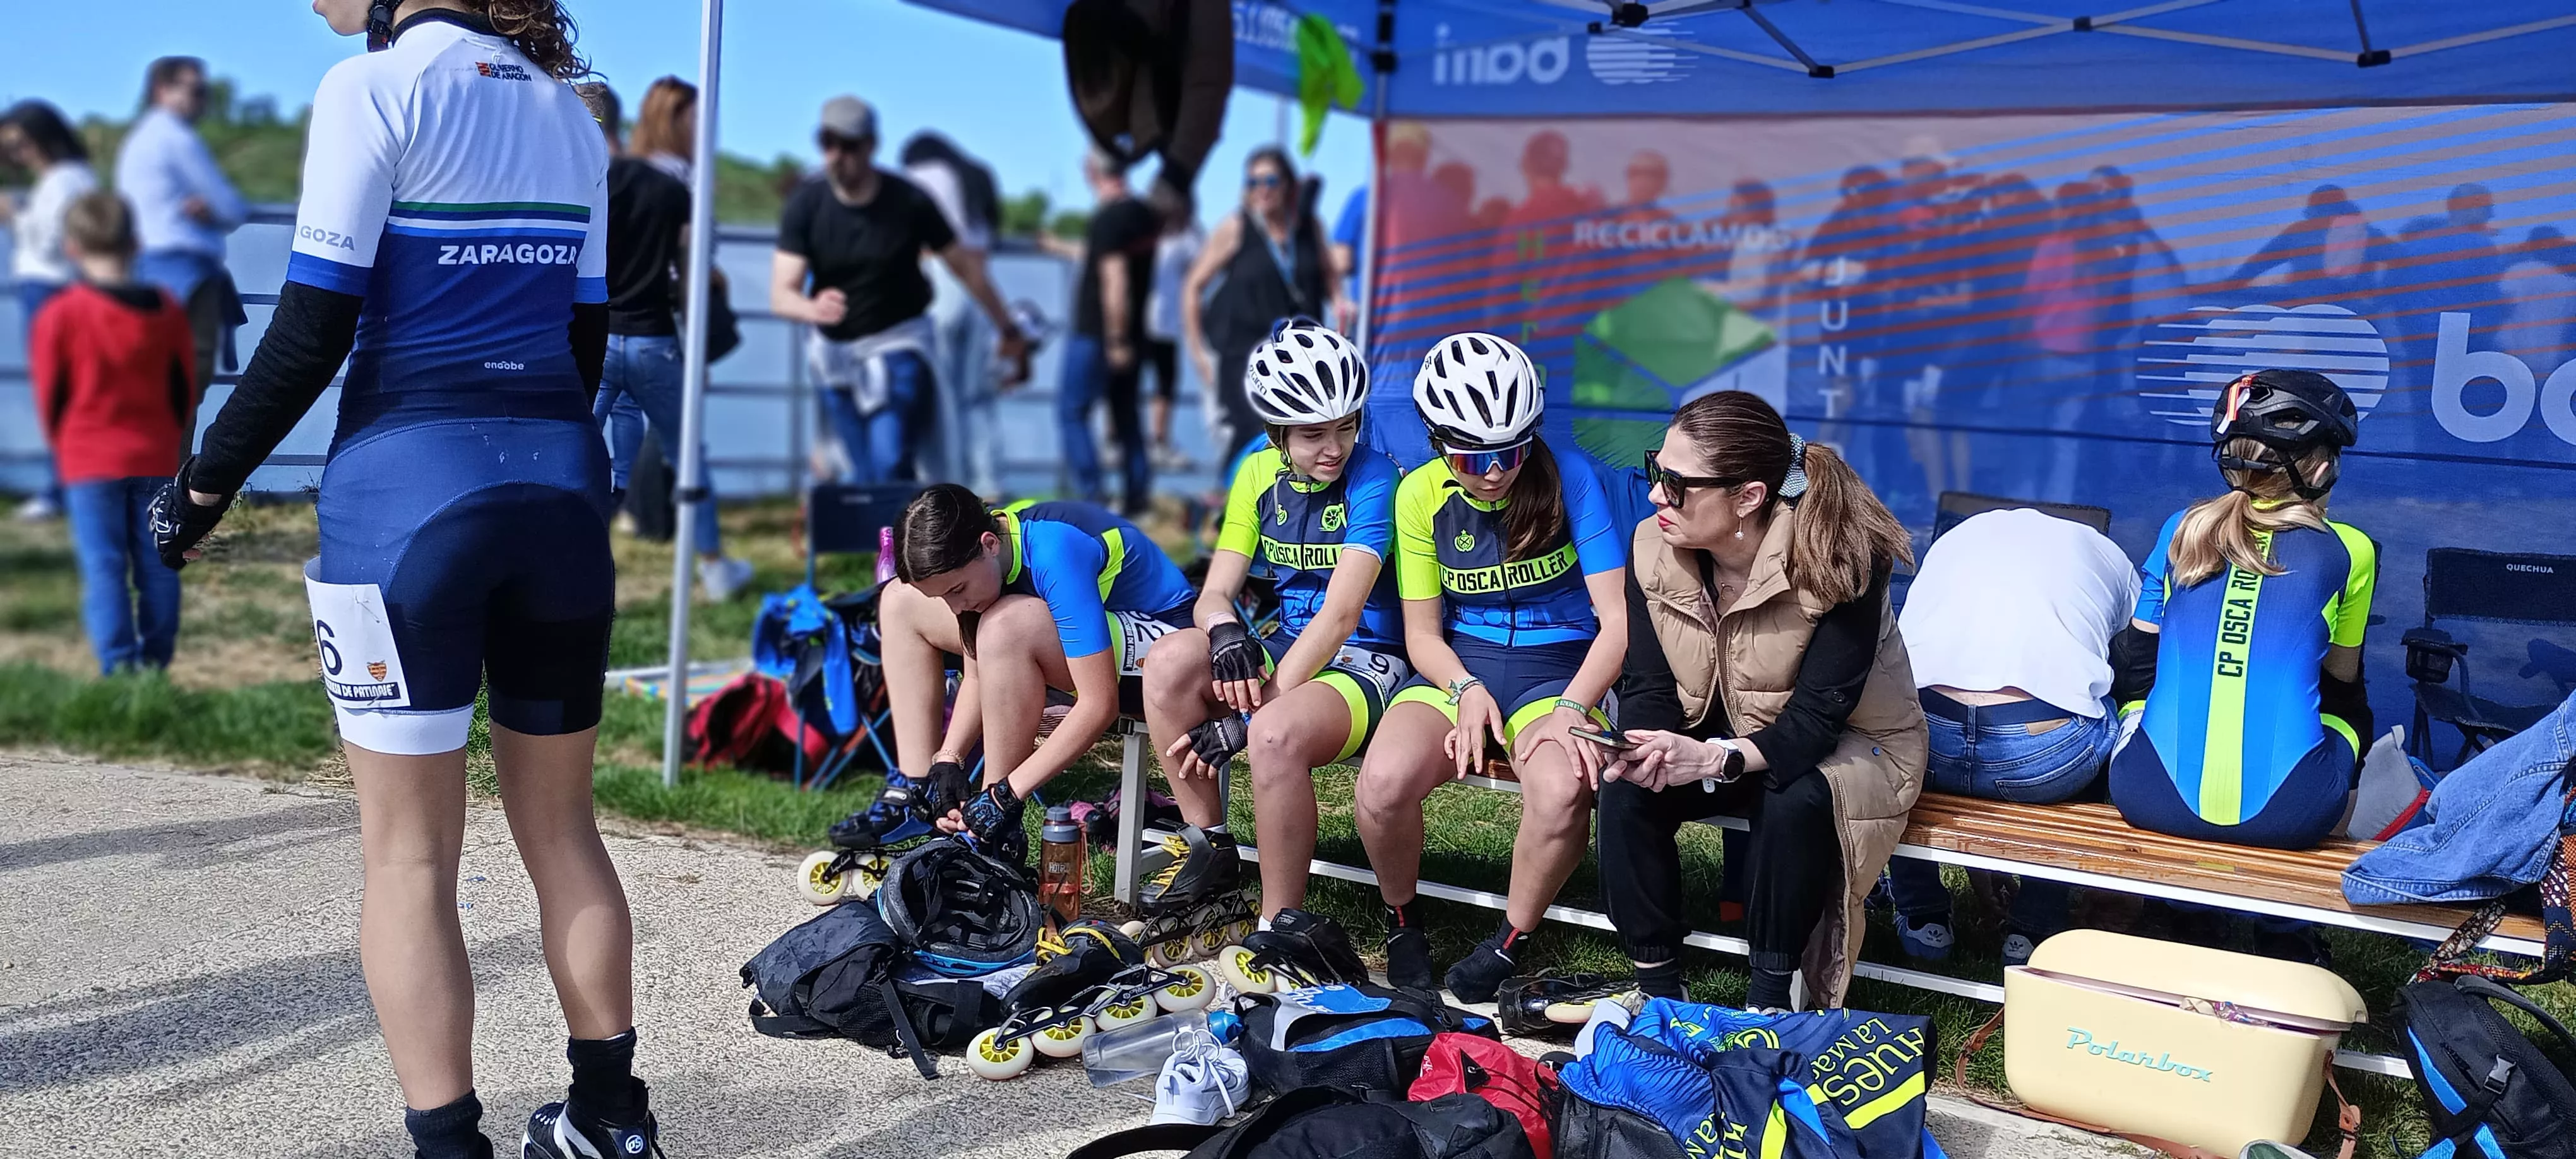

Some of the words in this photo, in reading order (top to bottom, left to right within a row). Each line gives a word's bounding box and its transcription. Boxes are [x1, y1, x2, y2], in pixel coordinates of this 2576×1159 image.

[491, 71, 501, 79] DE
[297, 225, 355, 251] GOZA
[1573, 219, 1792, 252] RECICLAMOS
[438, 244, 576, 265] ZARAGOZA
[1442, 569, 1455, 587] CP
[1457, 569, 1501, 591] OSCA
[1507, 551, 1569, 586] ROLLER
[2506, 563, 2554, 574] QUECHUA
[2221, 598, 2253, 645] OSCA
[2217, 650, 2244, 677] CP
[342, 684, 354, 698] DE
[1851, 1018, 1892, 1044] La
[2066, 1026, 2214, 1083] Polarbox
